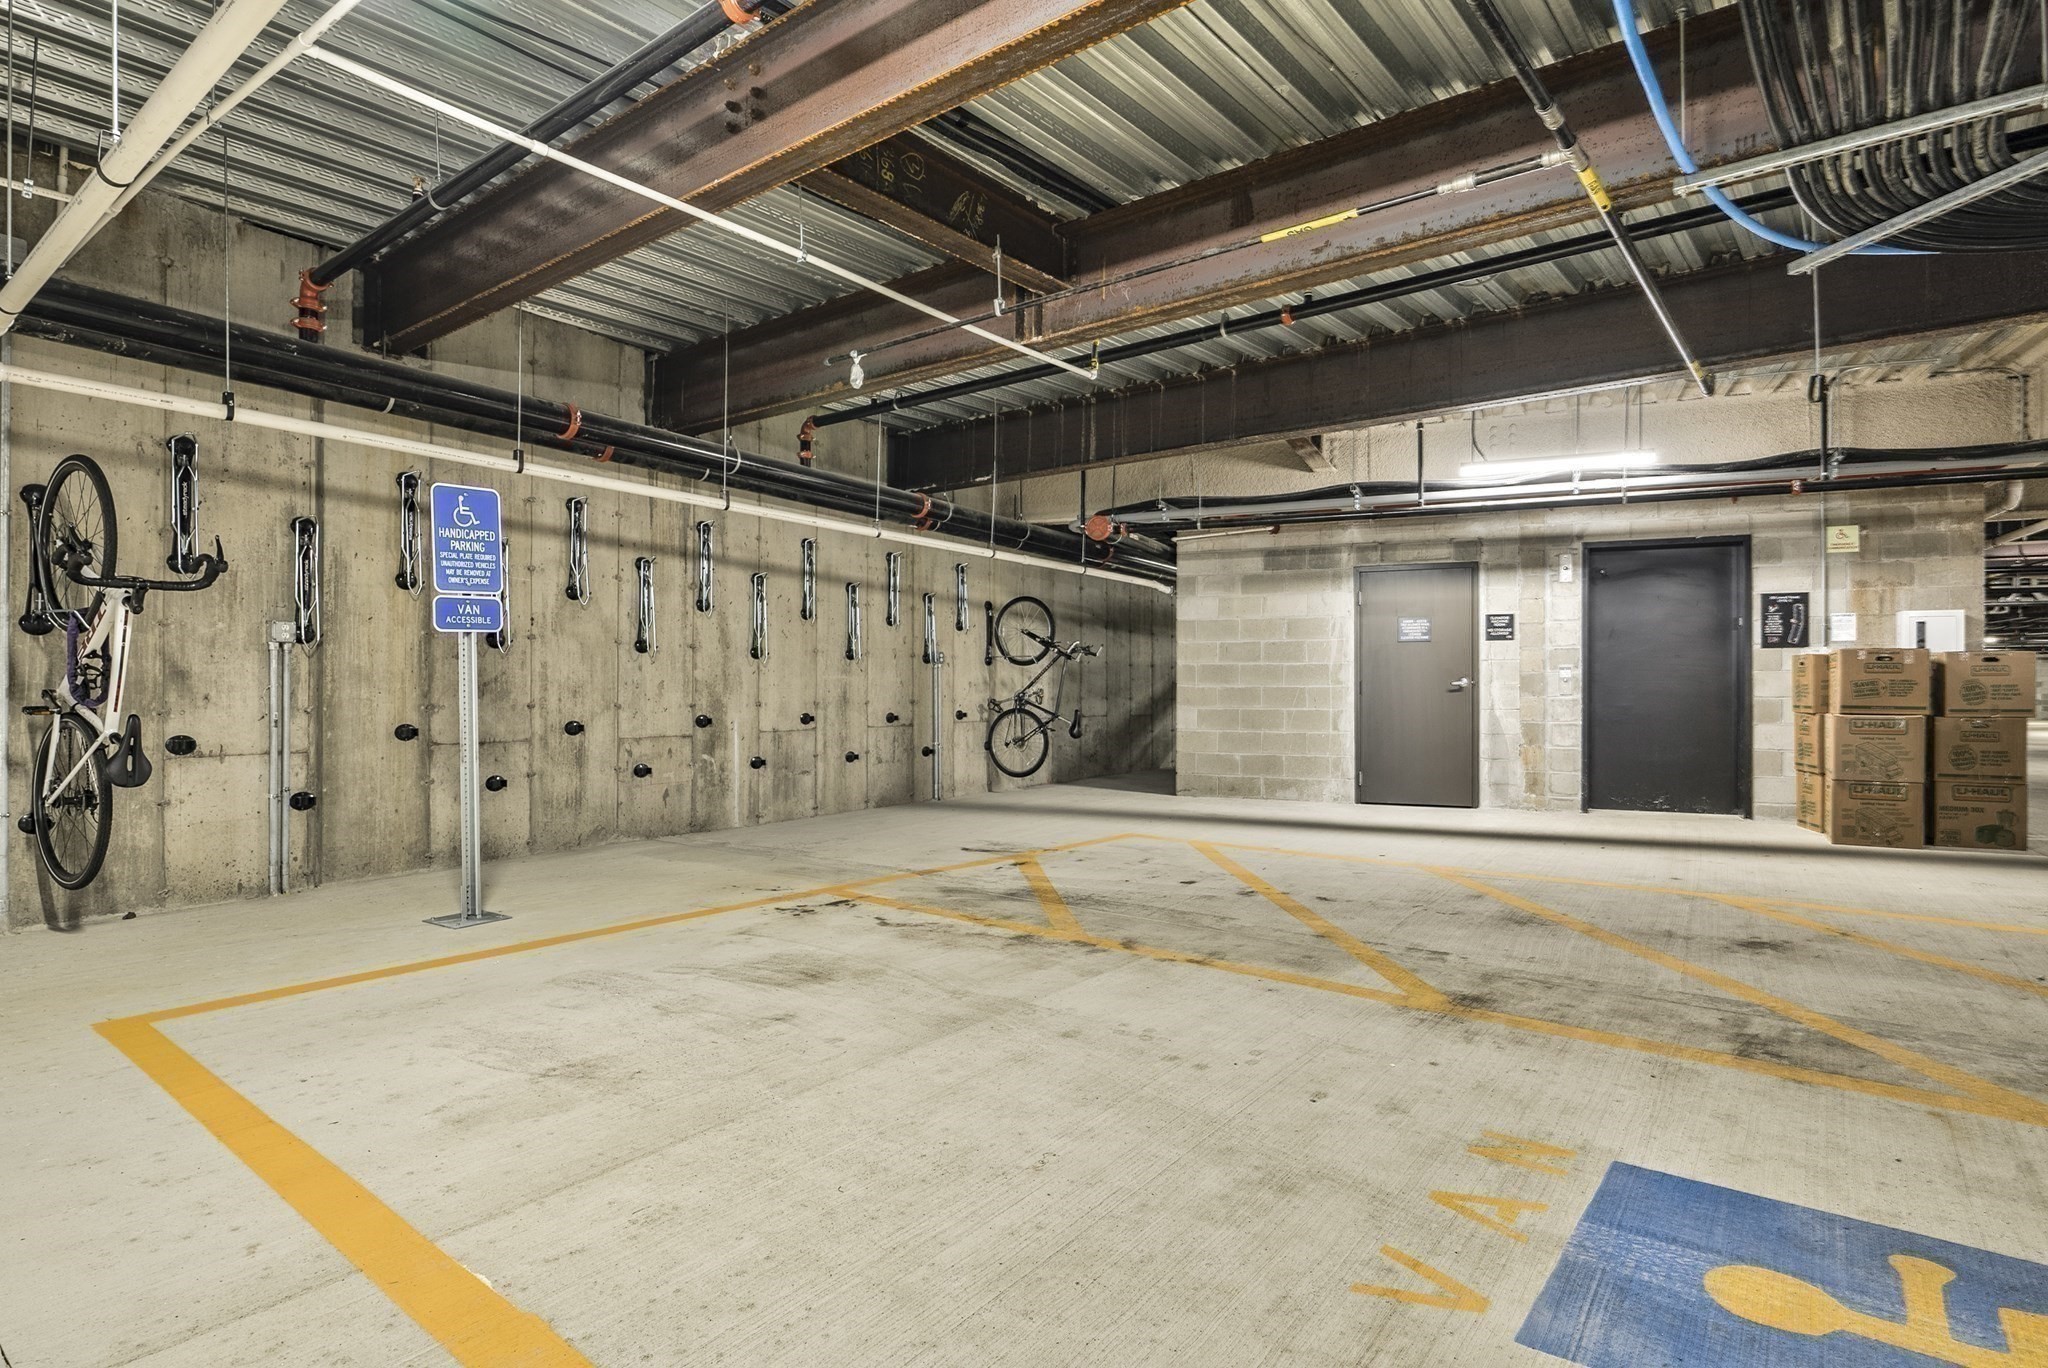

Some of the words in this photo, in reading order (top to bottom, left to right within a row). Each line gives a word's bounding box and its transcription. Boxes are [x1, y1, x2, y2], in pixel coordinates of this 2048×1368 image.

[438, 527, 496, 541] HANDICAPPED
[450, 540, 486, 552] PARKING
[440, 551, 458, 559] SPECIAL
[474, 553, 496, 561] REQUIRED
[440, 560, 474, 568] UNAUTHORIZED
[469, 577, 490, 585] EXPENSE
[457, 604, 481, 615] VAN
[445, 615, 492, 625] ACCESSIBLE
[1955, 787, 2009, 797] U-HAUL
[1349, 1130, 1577, 1314] VAN
